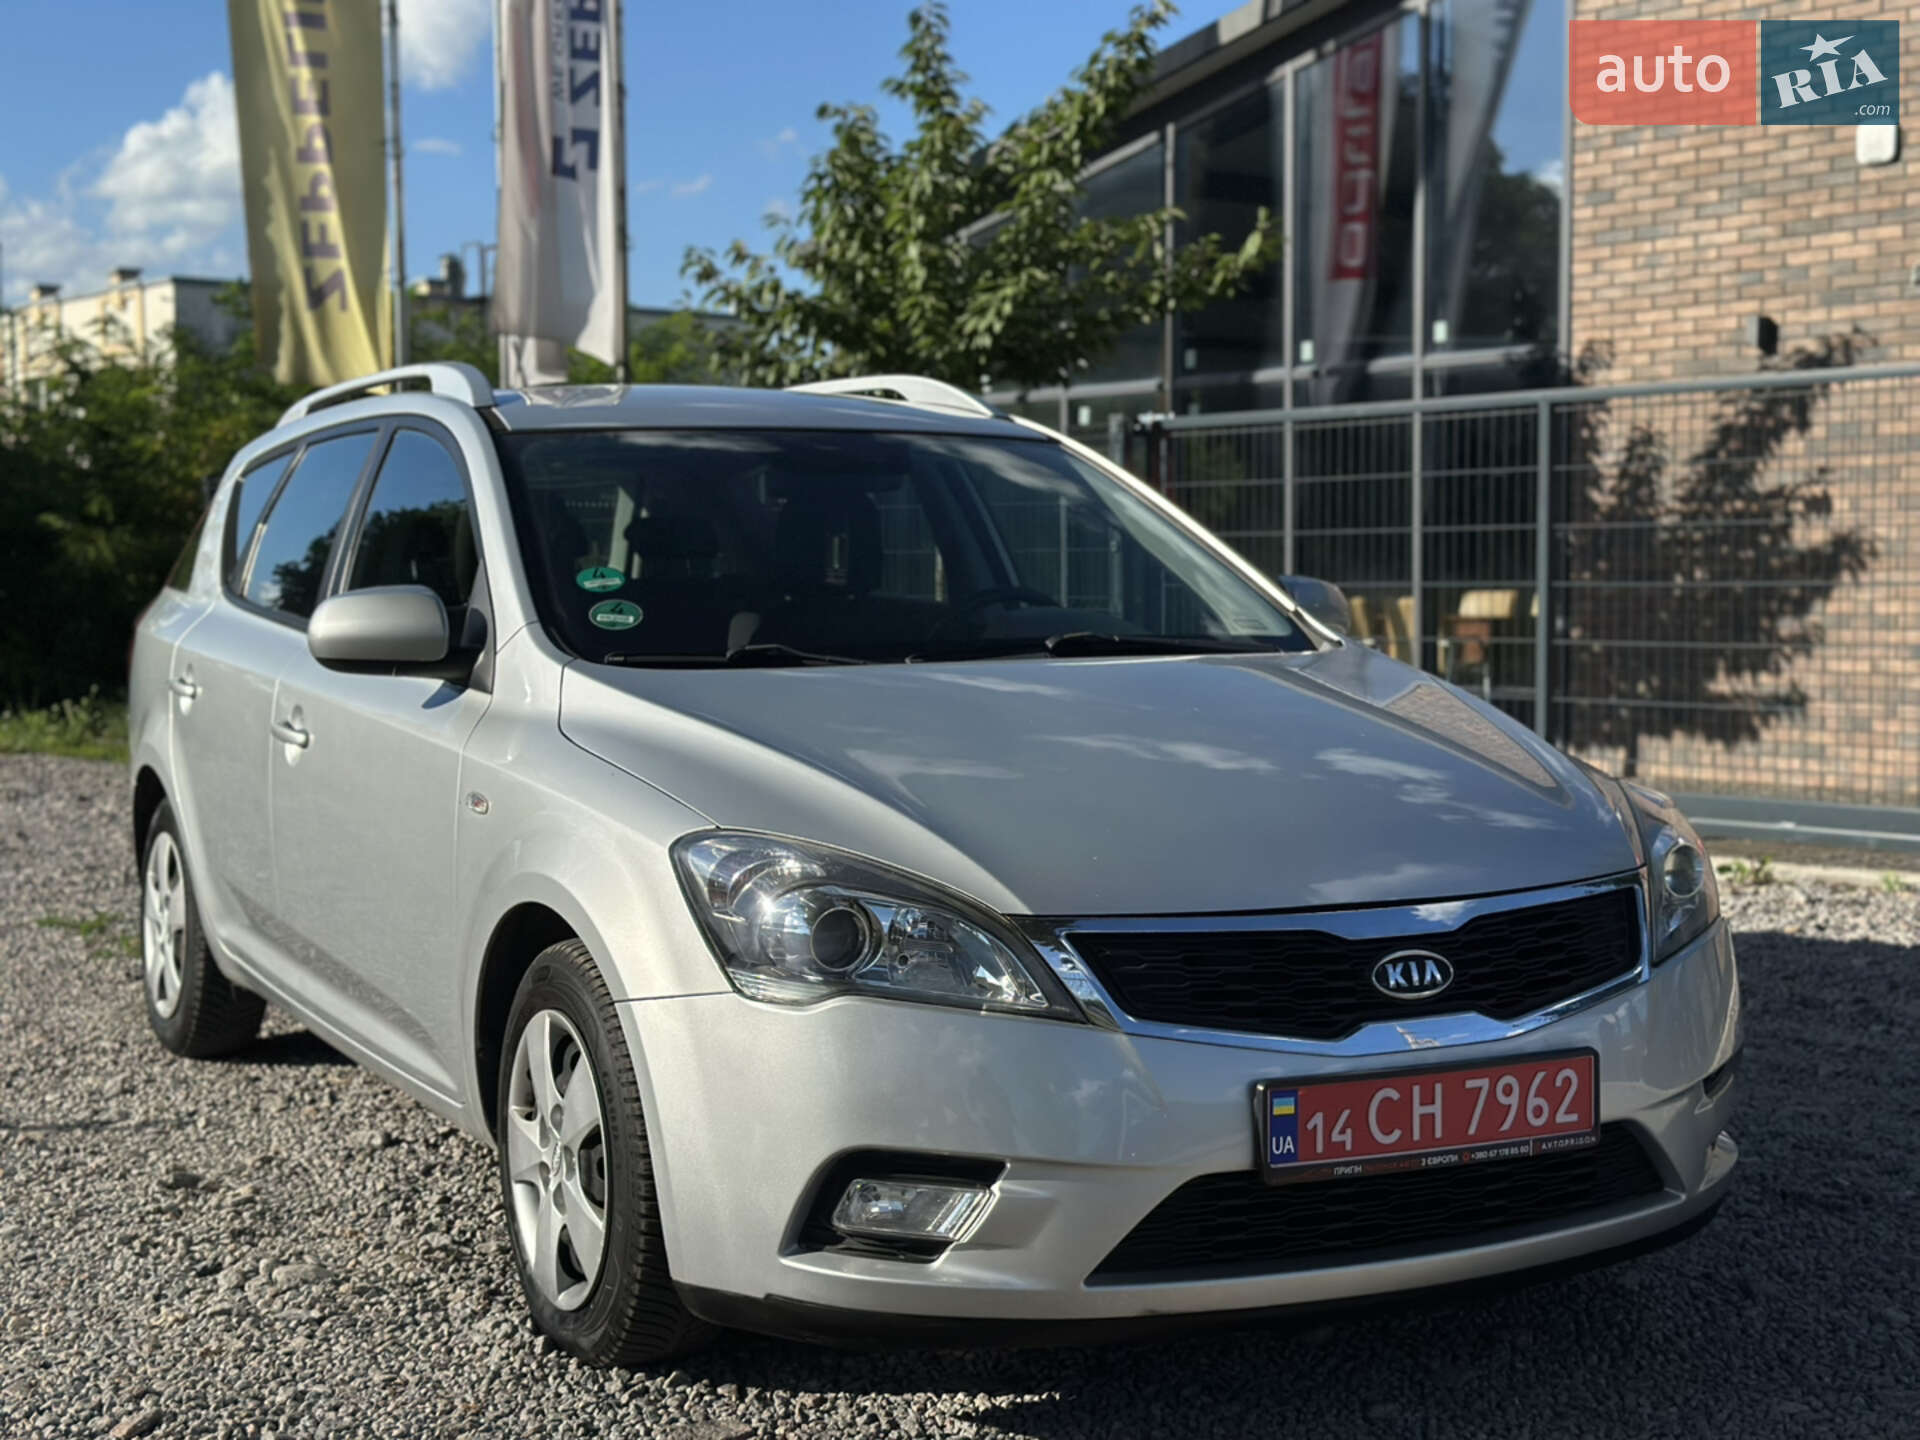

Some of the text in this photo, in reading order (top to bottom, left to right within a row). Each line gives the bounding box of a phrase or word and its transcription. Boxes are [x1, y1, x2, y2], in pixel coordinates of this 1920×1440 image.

[1384, 960, 1442, 989] KIA
[1306, 1068, 1580, 1154] 14 CH 7962
[1272, 1135, 1295, 1155] UA
